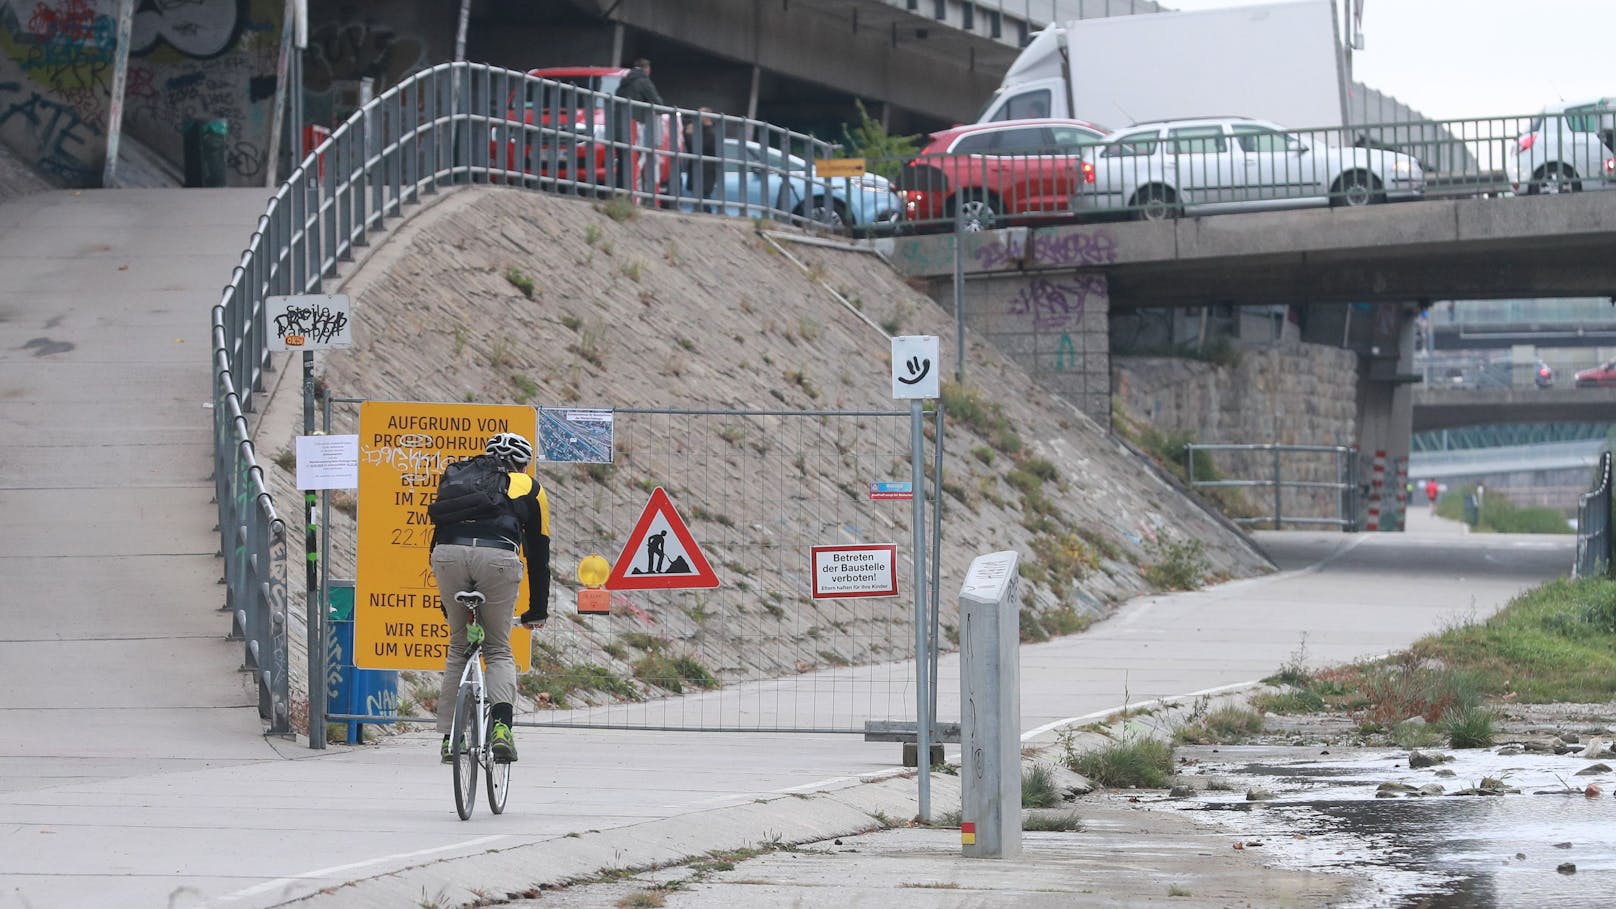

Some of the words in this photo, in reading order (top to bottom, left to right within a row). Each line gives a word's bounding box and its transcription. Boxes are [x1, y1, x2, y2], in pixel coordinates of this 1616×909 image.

[387, 415, 471, 431] AUFGRUND
[478, 418, 508, 432] VON
[394, 492, 413, 506] IM
[833, 553, 874, 562] Betreten
[822, 563, 838, 573] der
[841, 563, 885, 572] Baustelle
[831, 573, 877, 583] verboten!
[370, 593, 416, 608] NICHT
[385, 622, 414, 637] WIR
[421, 624, 452, 638] ERS
[375, 642, 397, 656] UM
